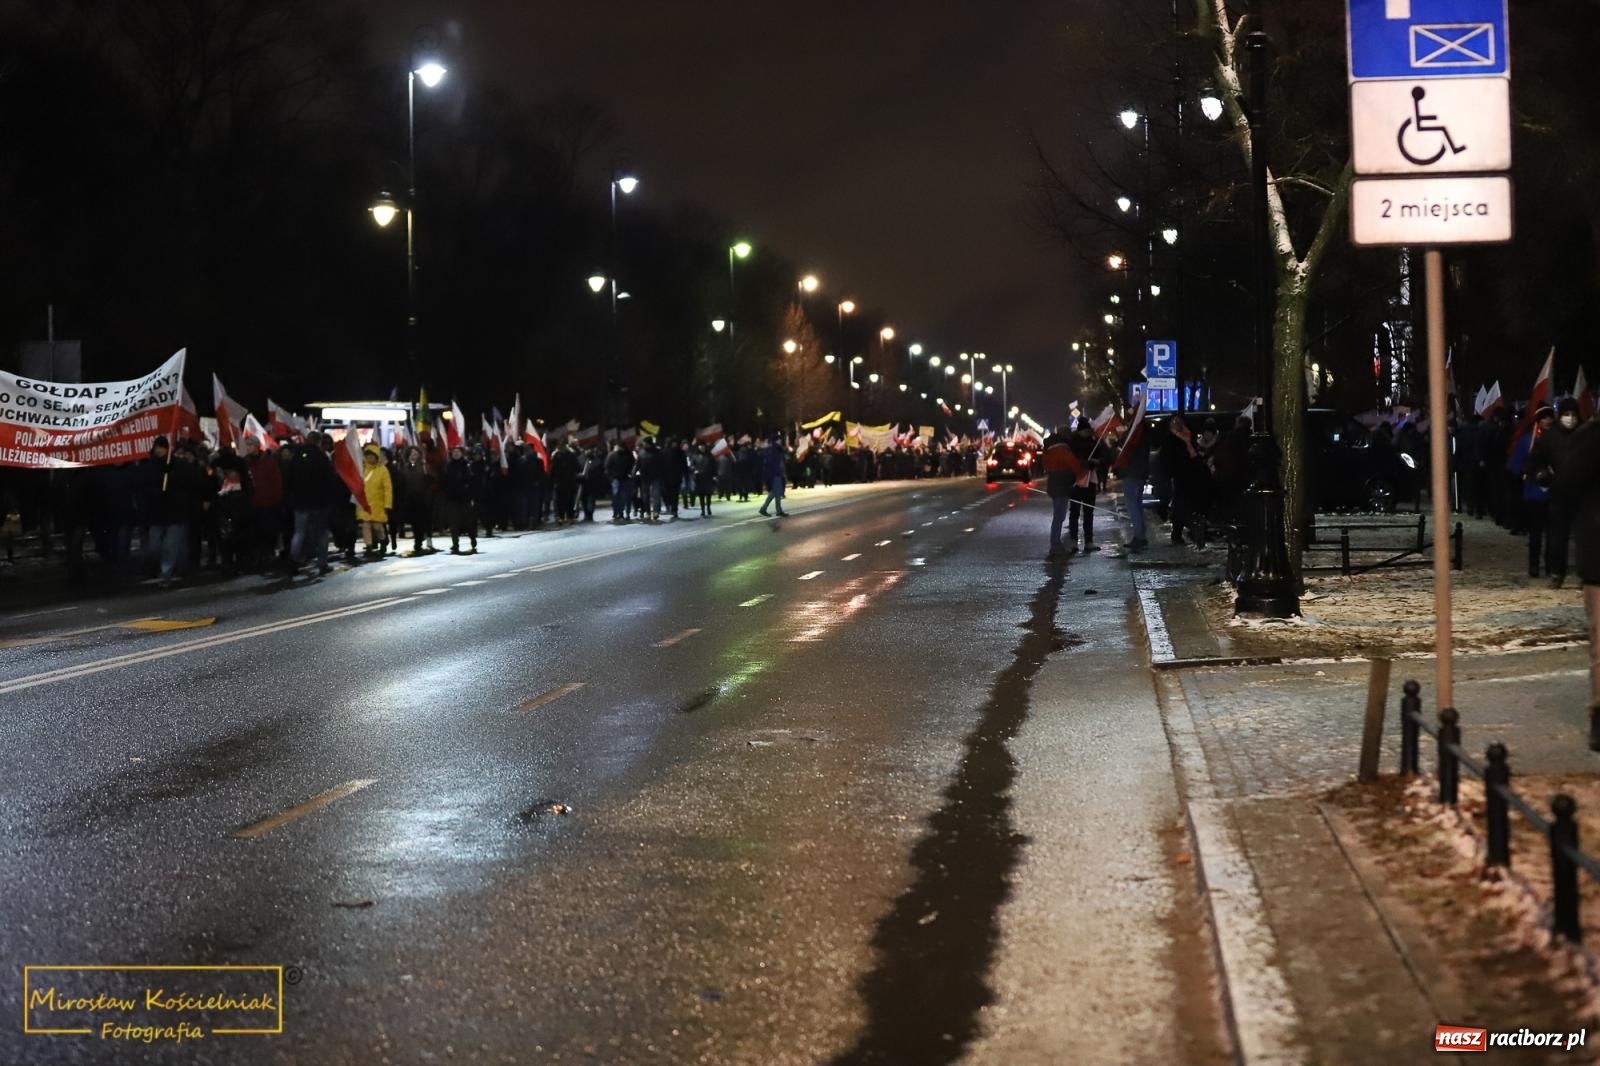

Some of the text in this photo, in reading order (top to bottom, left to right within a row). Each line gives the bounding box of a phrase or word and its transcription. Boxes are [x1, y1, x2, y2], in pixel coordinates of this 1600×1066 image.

[1381, 198, 1489, 222] 2 miejsca
[1153, 344, 1170, 367] P
[16, 379, 108, 399] GOŁDAP
[16, 394, 37, 408] CO
[53, 433, 75, 447] BEZ
